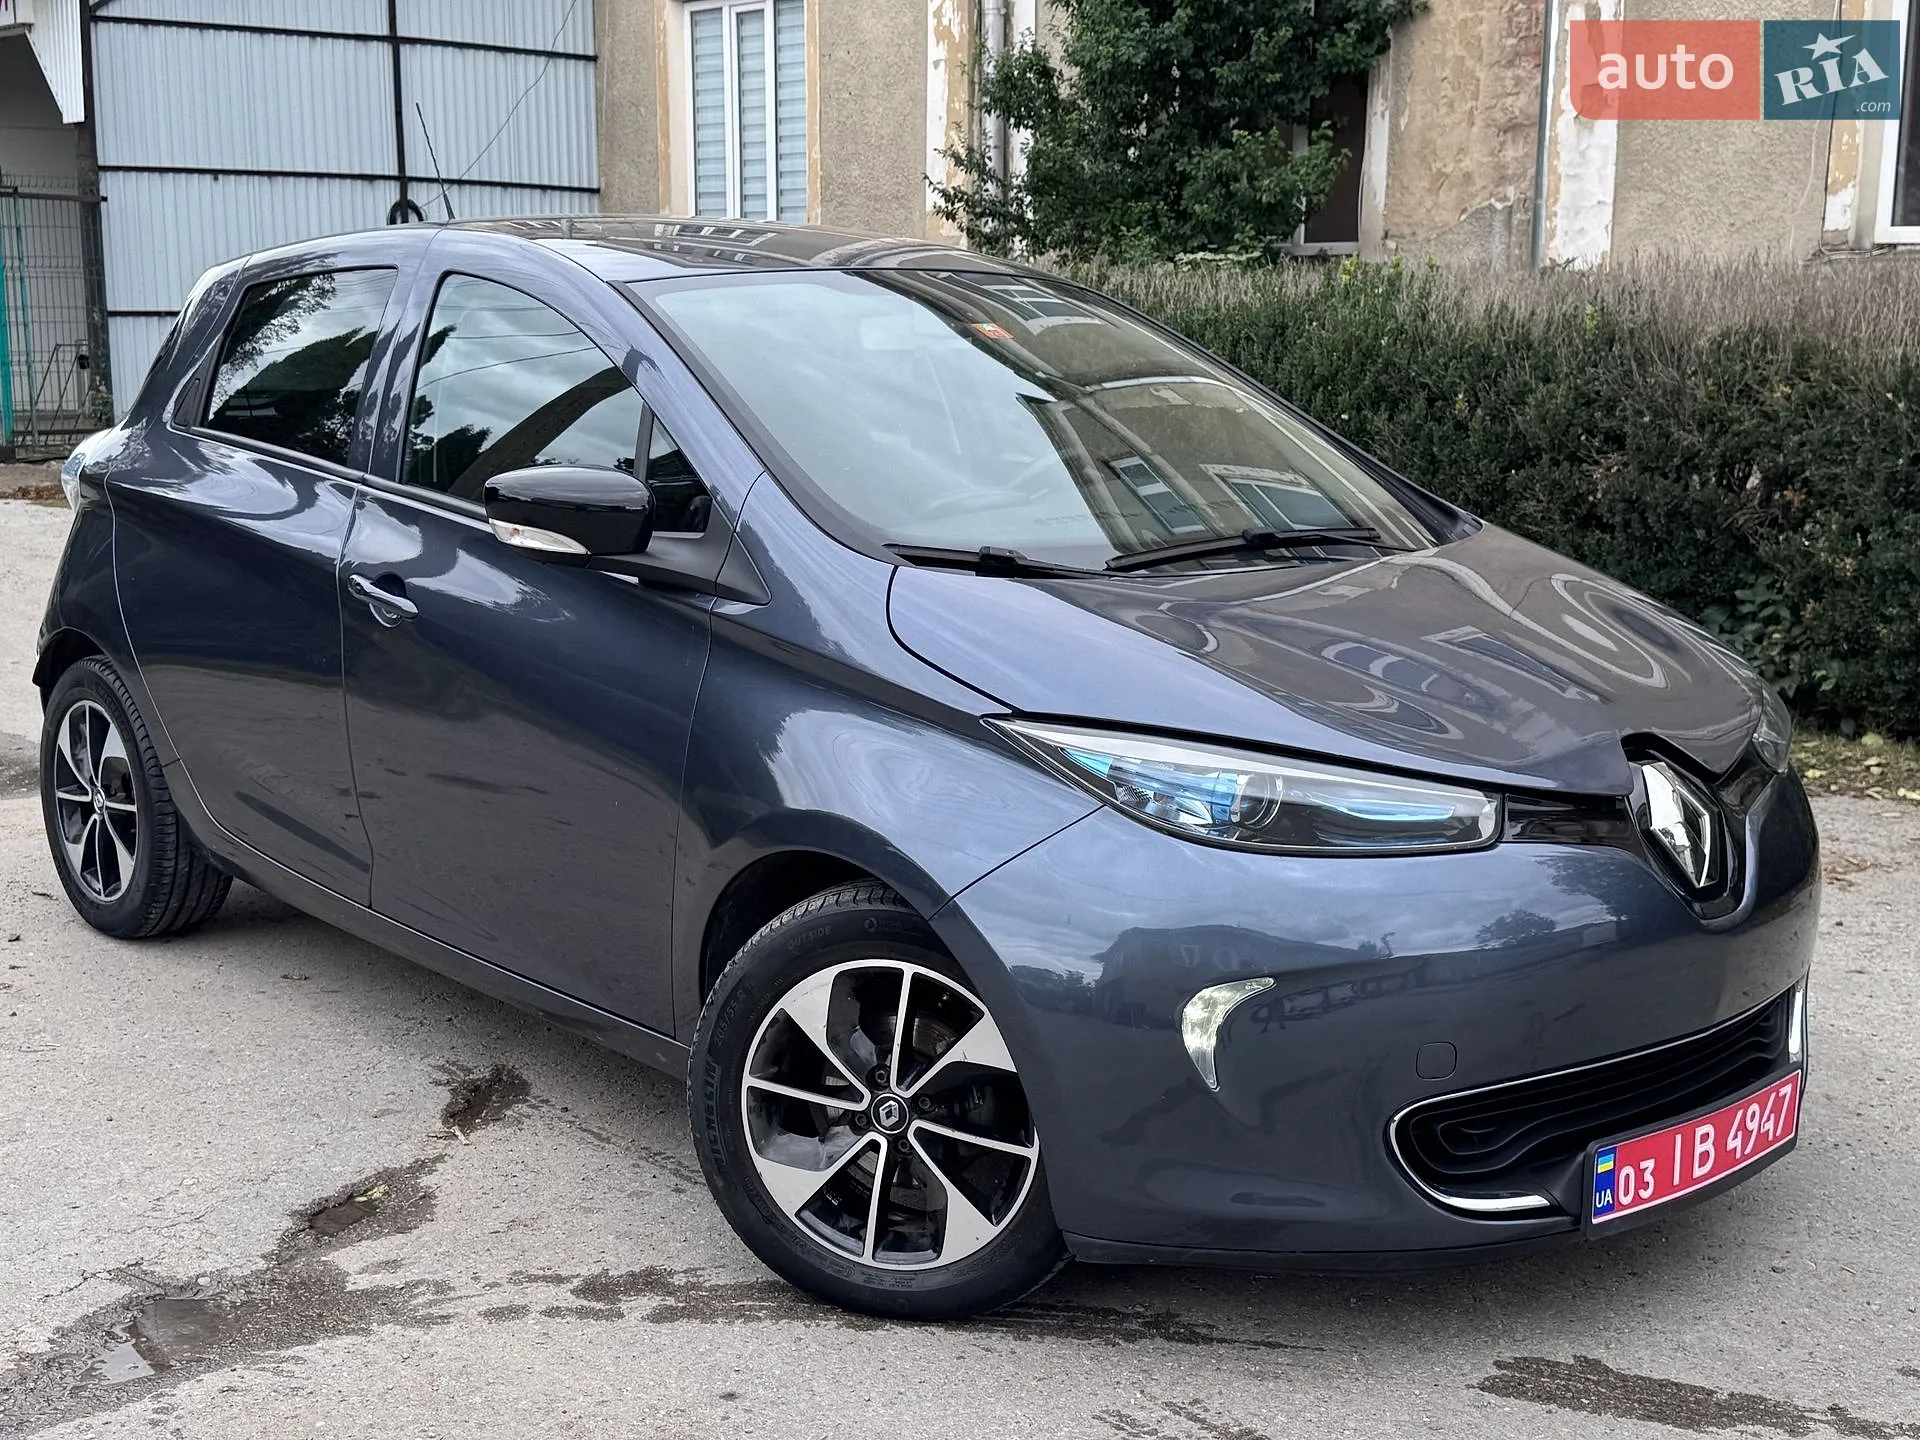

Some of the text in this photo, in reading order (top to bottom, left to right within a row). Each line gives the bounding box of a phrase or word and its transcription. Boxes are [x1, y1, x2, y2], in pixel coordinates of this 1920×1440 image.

[704, 1060, 726, 1174] MICHELIN
[1618, 1083, 1793, 1206] 03 IB 4947
[1595, 1189, 1613, 1208] UA
